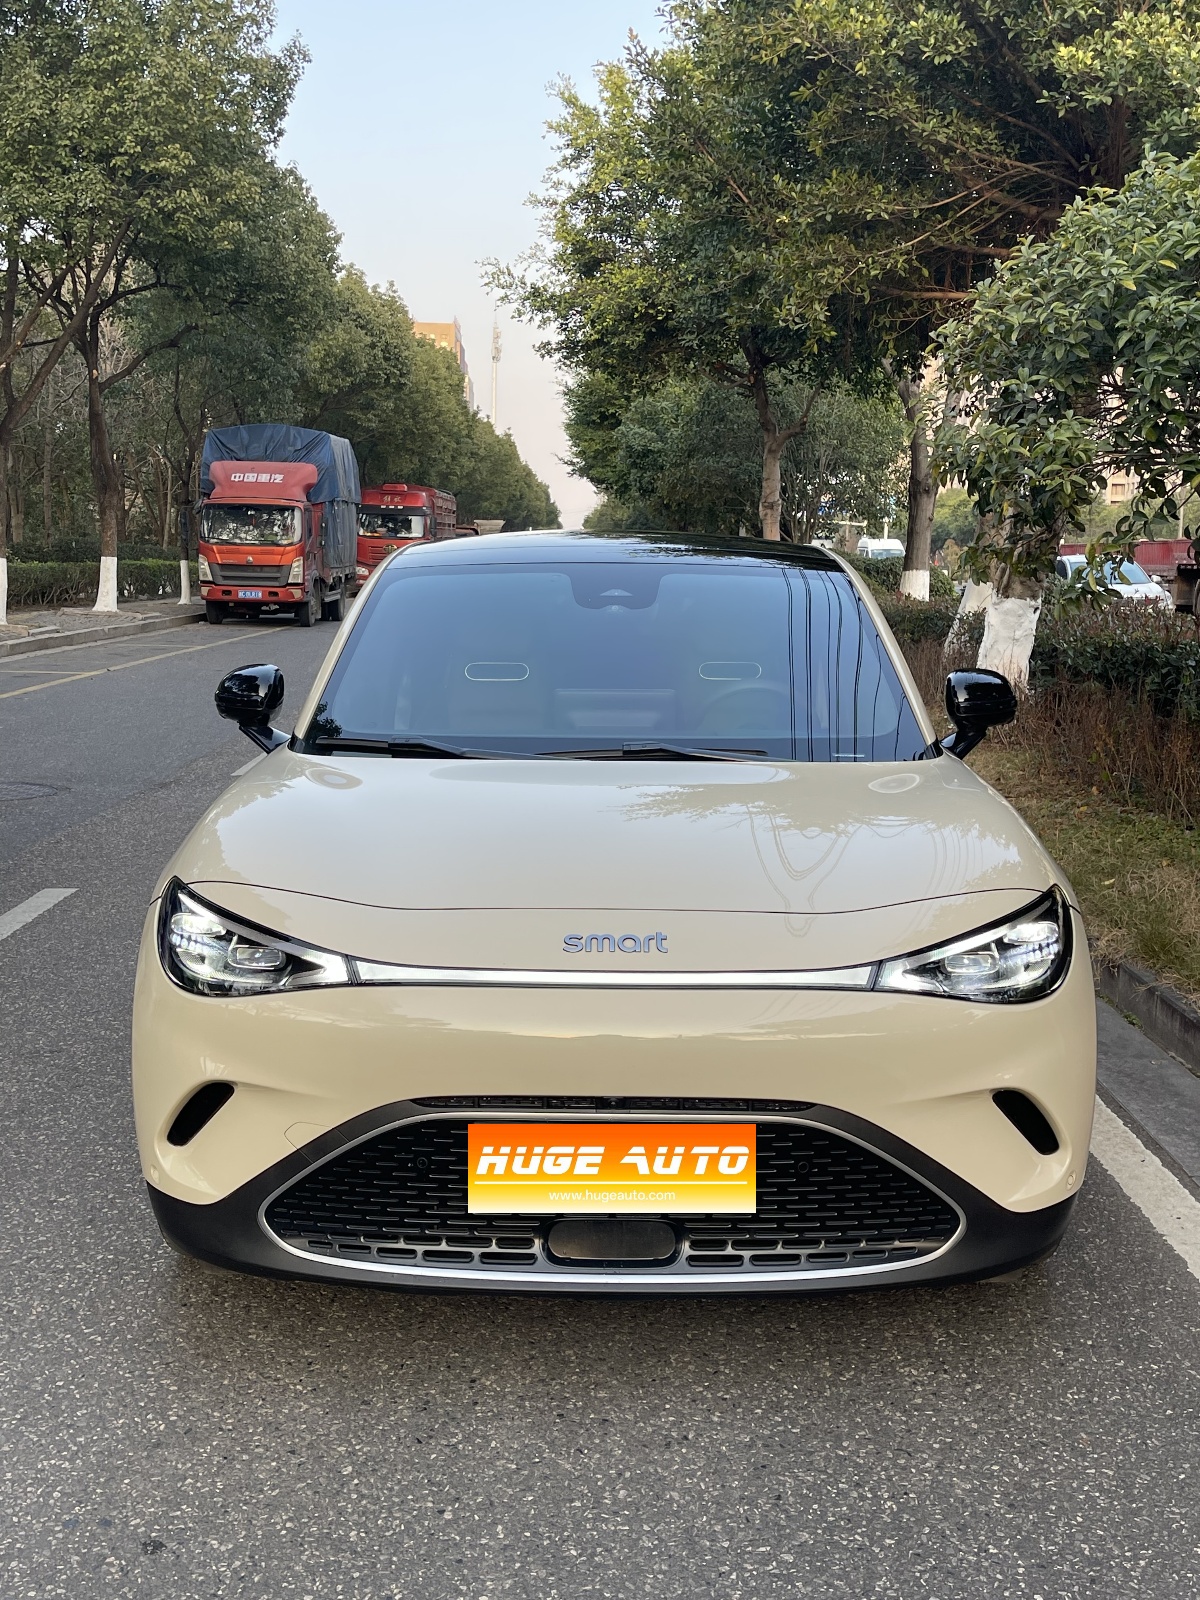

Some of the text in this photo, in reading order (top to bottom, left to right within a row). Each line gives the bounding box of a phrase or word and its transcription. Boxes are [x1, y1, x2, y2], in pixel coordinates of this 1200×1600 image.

[231, 473, 284, 483] 中国重汽
[563, 932, 668, 953] smart
